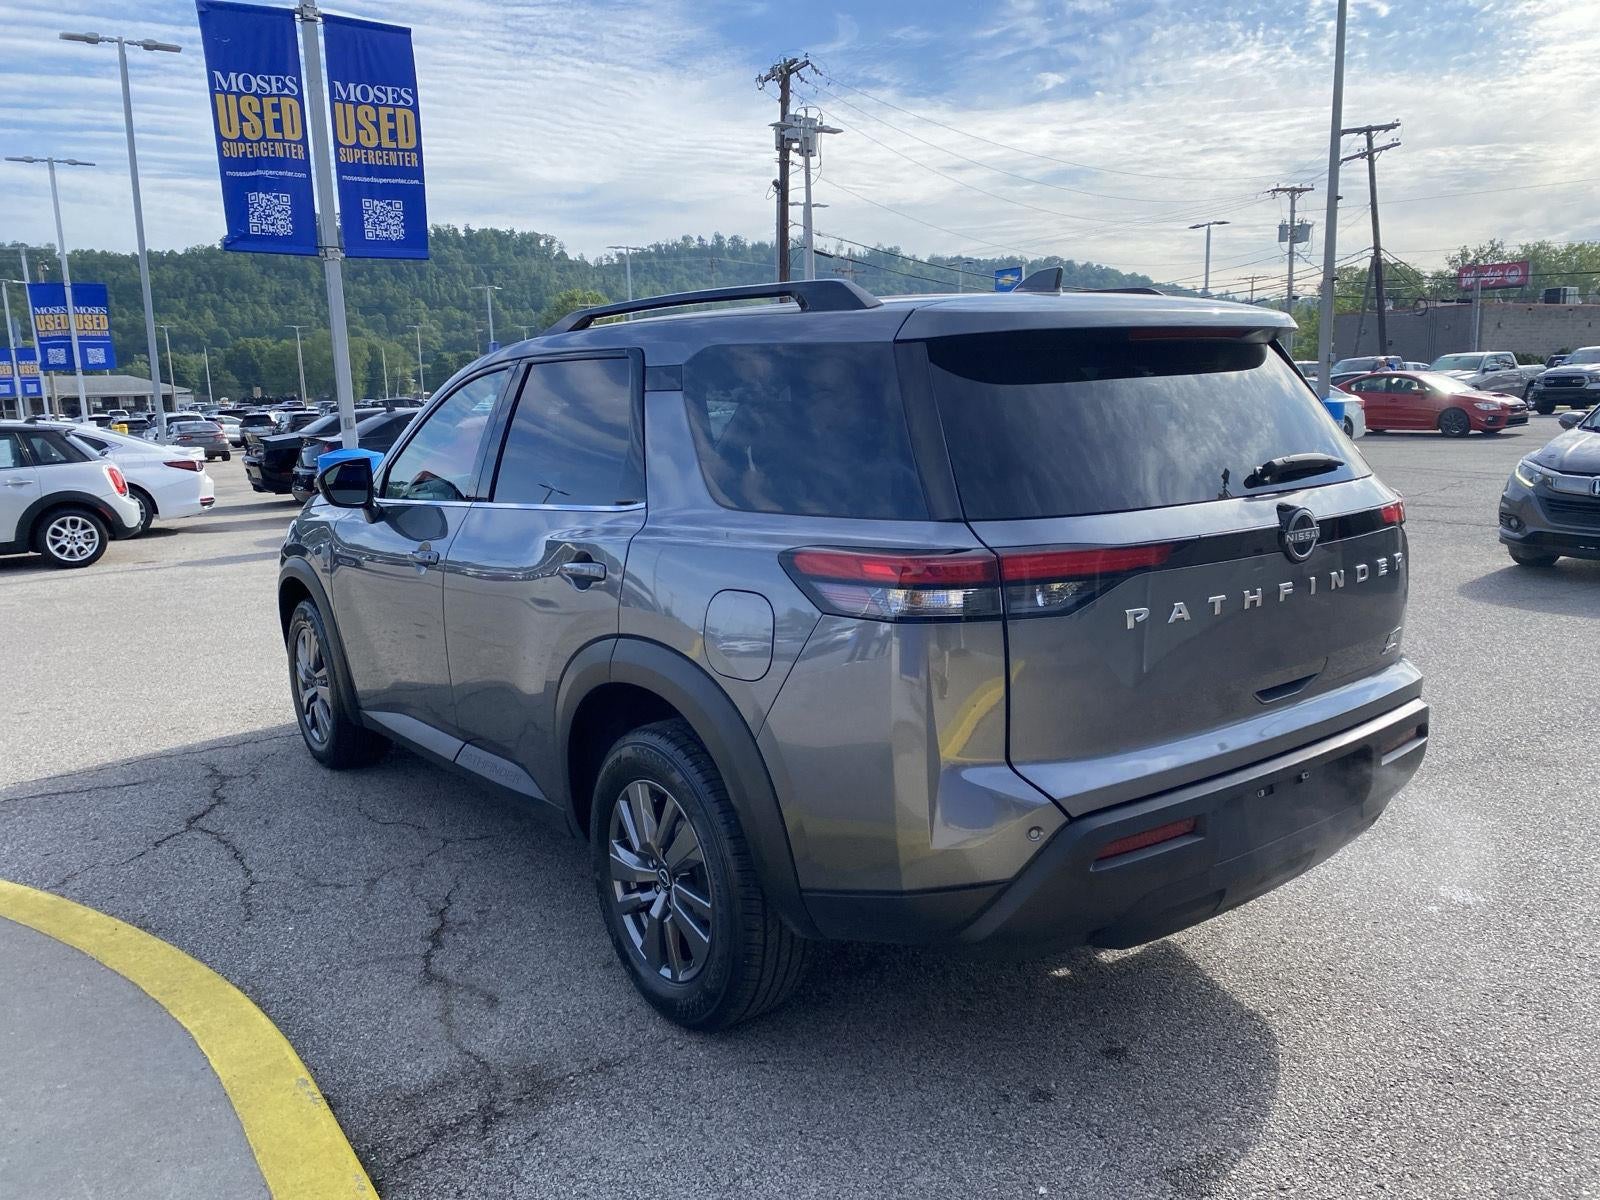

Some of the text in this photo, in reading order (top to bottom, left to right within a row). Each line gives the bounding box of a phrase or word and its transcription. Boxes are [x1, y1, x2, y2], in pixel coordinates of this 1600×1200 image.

[213, 71, 298, 95] MOSES
[333, 81, 413, 106] MOSES
[215, 94, 303, 140] USED
[335, 103, 417, 149] USED
[222, 141, 305, 160] SUPERCENTER
[339, 147, 419, 168] SUPERCENTER
[226, 169, 307, 179] mosesusedsupercenter.com
[342, 175, 420, 185] mosesusedsupercenter.com
[1462, 267, 1503, 287] Wndy's
[35, 315, 69, 330] USED
[75, 315, 109, 330] USED
[1286, 530, 1320, 542] NISSAN
